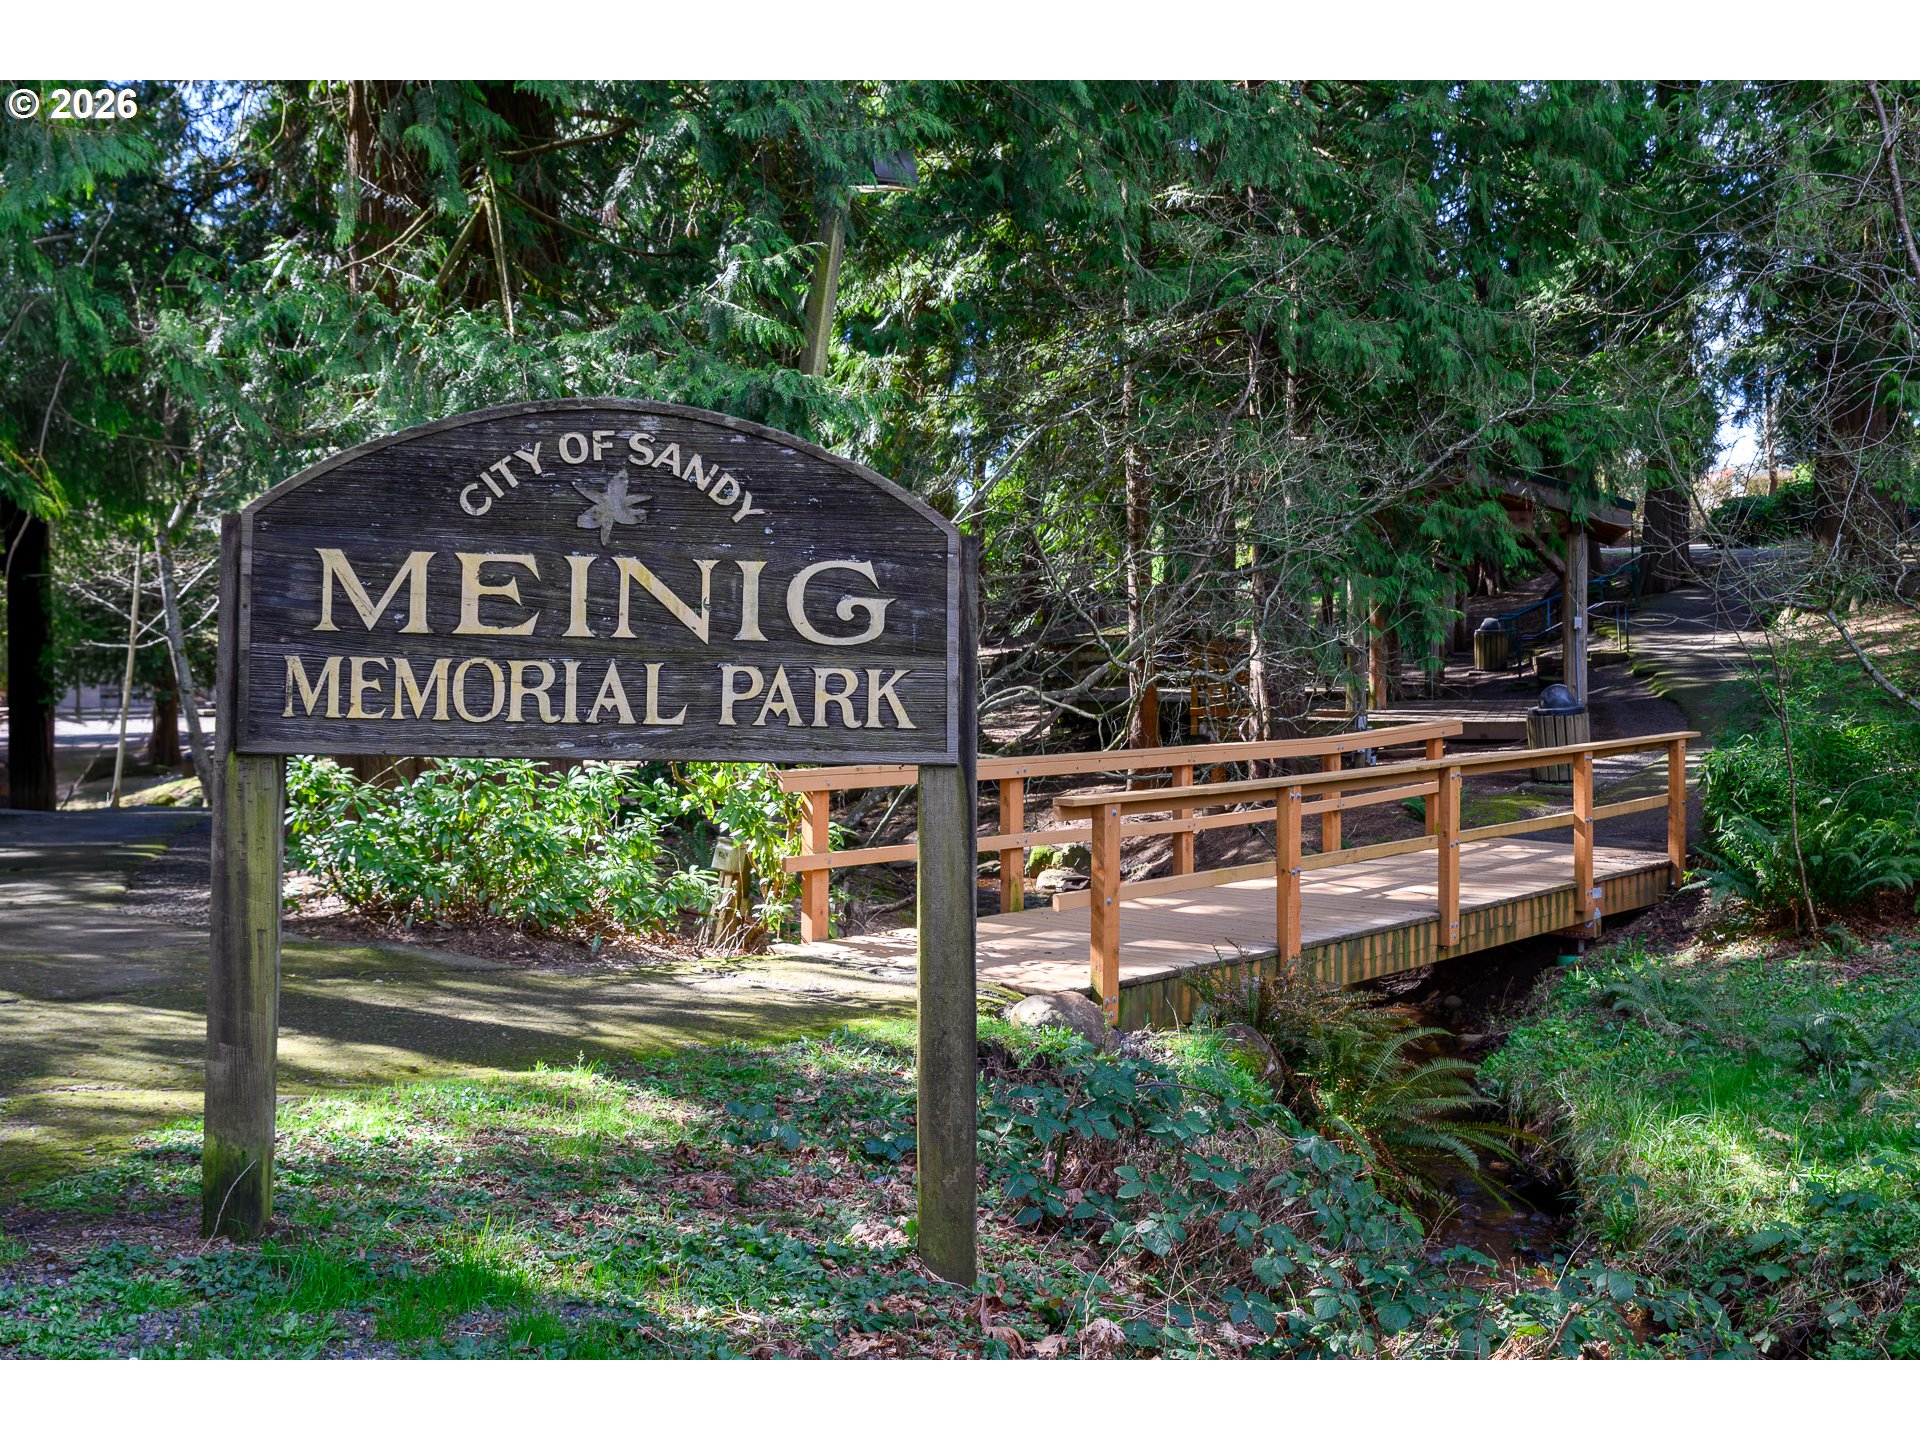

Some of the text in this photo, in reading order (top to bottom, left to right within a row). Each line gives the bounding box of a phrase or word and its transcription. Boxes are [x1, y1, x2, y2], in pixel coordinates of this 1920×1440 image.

[459, 430, 766, 524] CITY OF SANDY
[312, 547, 897, 646] MEINIG
[282, 655, 918, 730] MEMORIAL PARK
